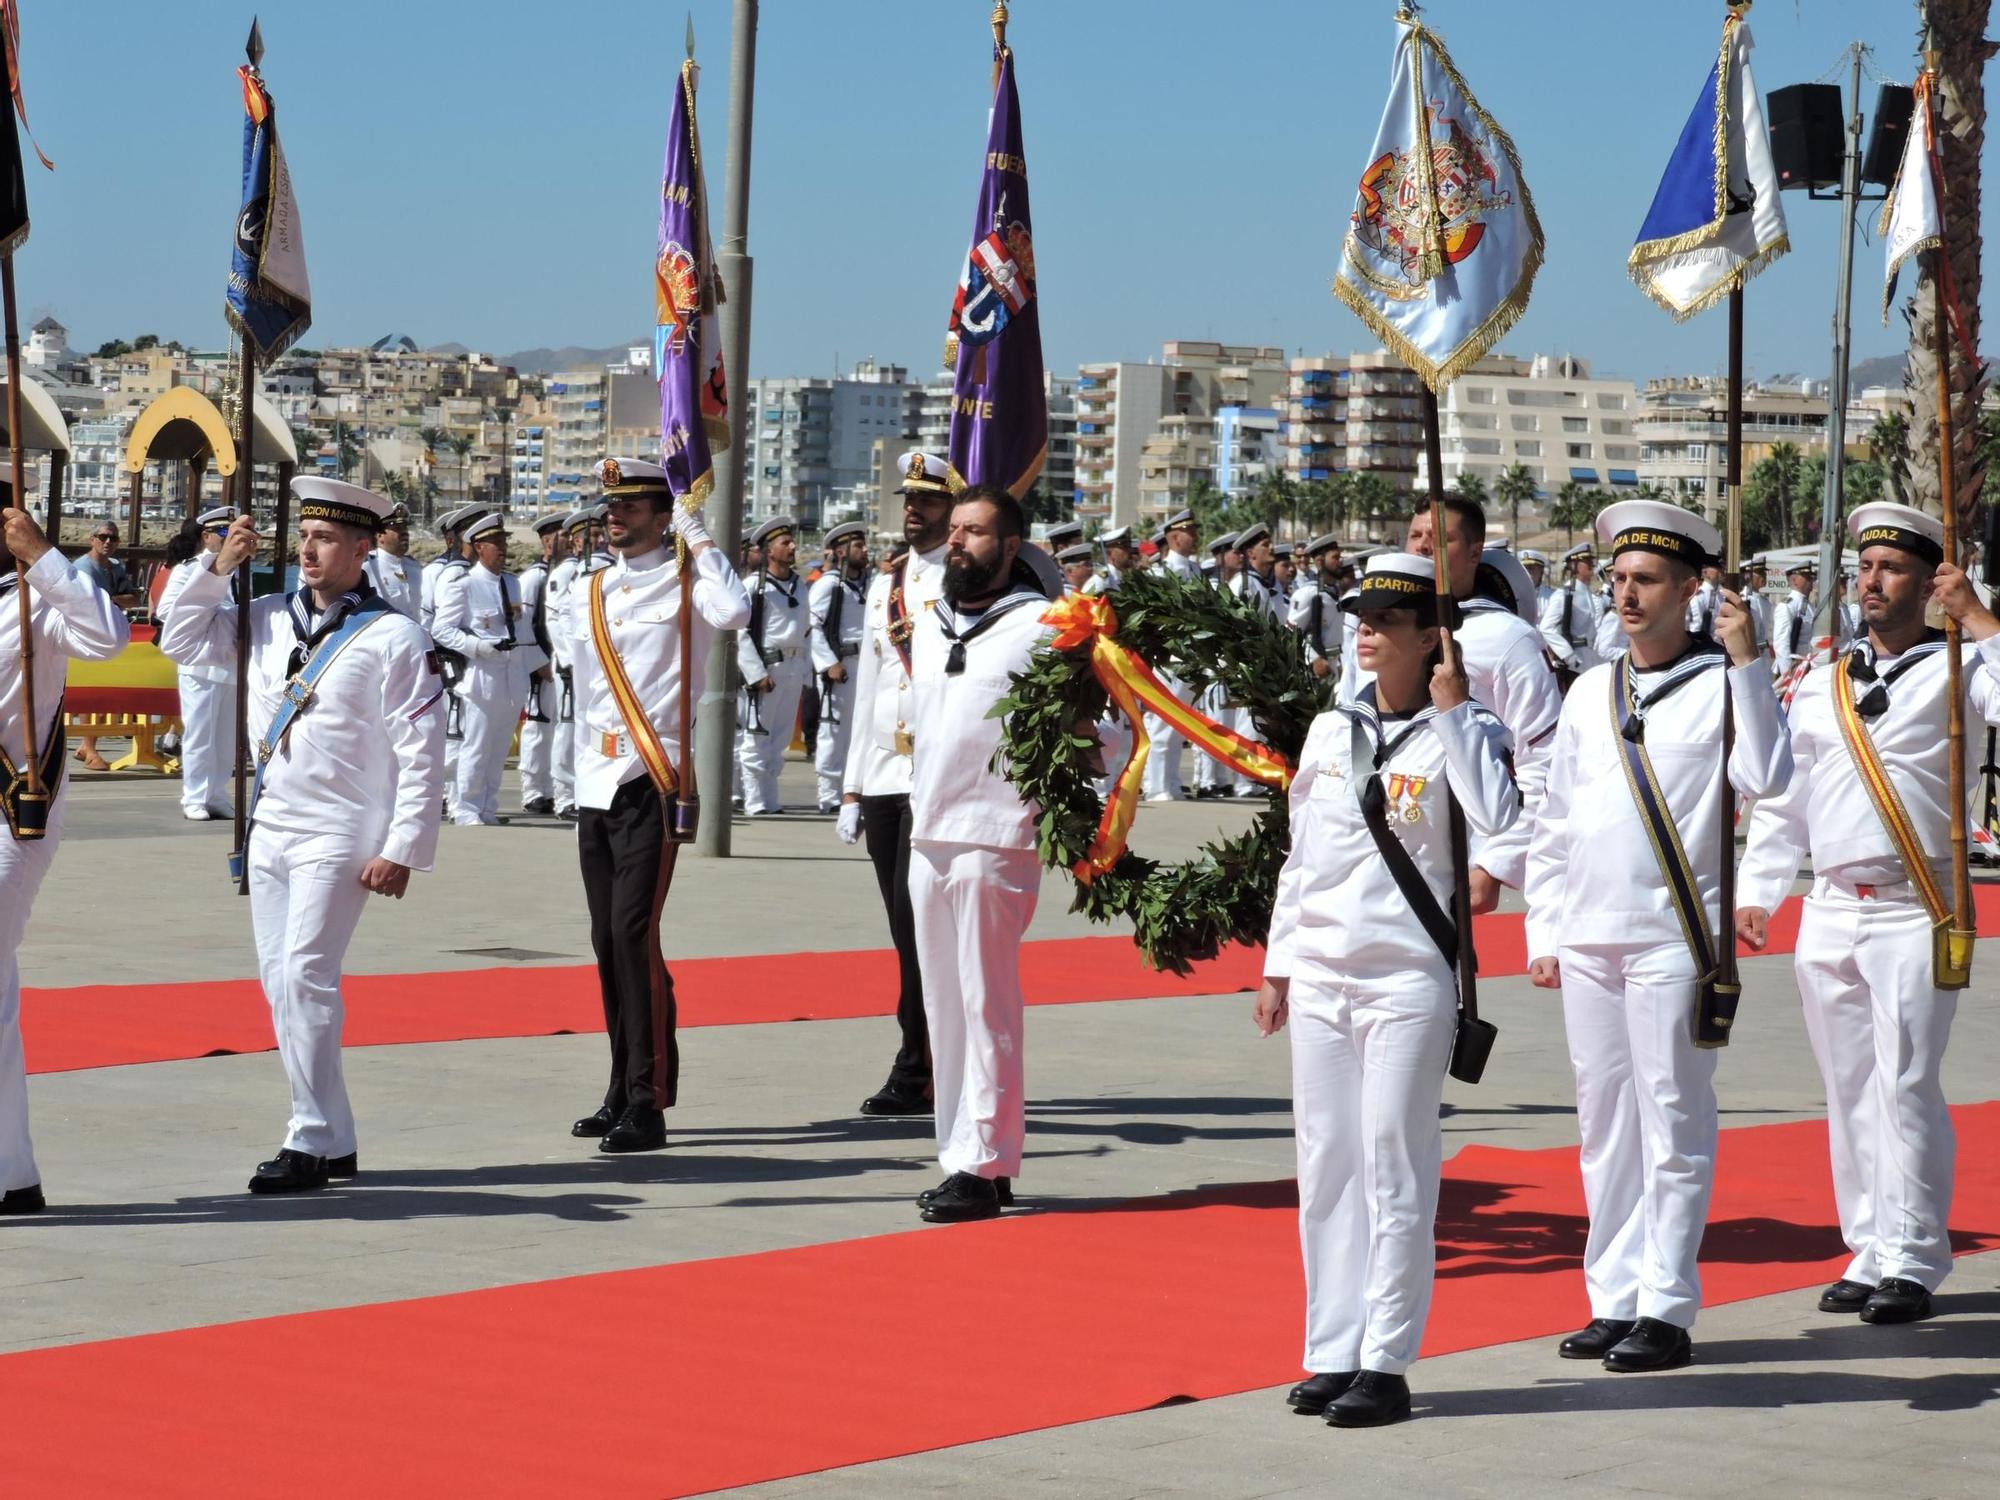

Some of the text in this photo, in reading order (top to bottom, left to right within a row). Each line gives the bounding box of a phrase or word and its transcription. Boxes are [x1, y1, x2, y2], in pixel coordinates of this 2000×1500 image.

[987, 152, 1026, 178] FUER
[279, 201, 291, 253] ARMADA
[1631, 532, 1649, 544] DE
[1651, 534, 1680, 551] MCM
[1861, 529, 1899, 544] AUDAZ
[1361, 578, 1373, 590] DE
